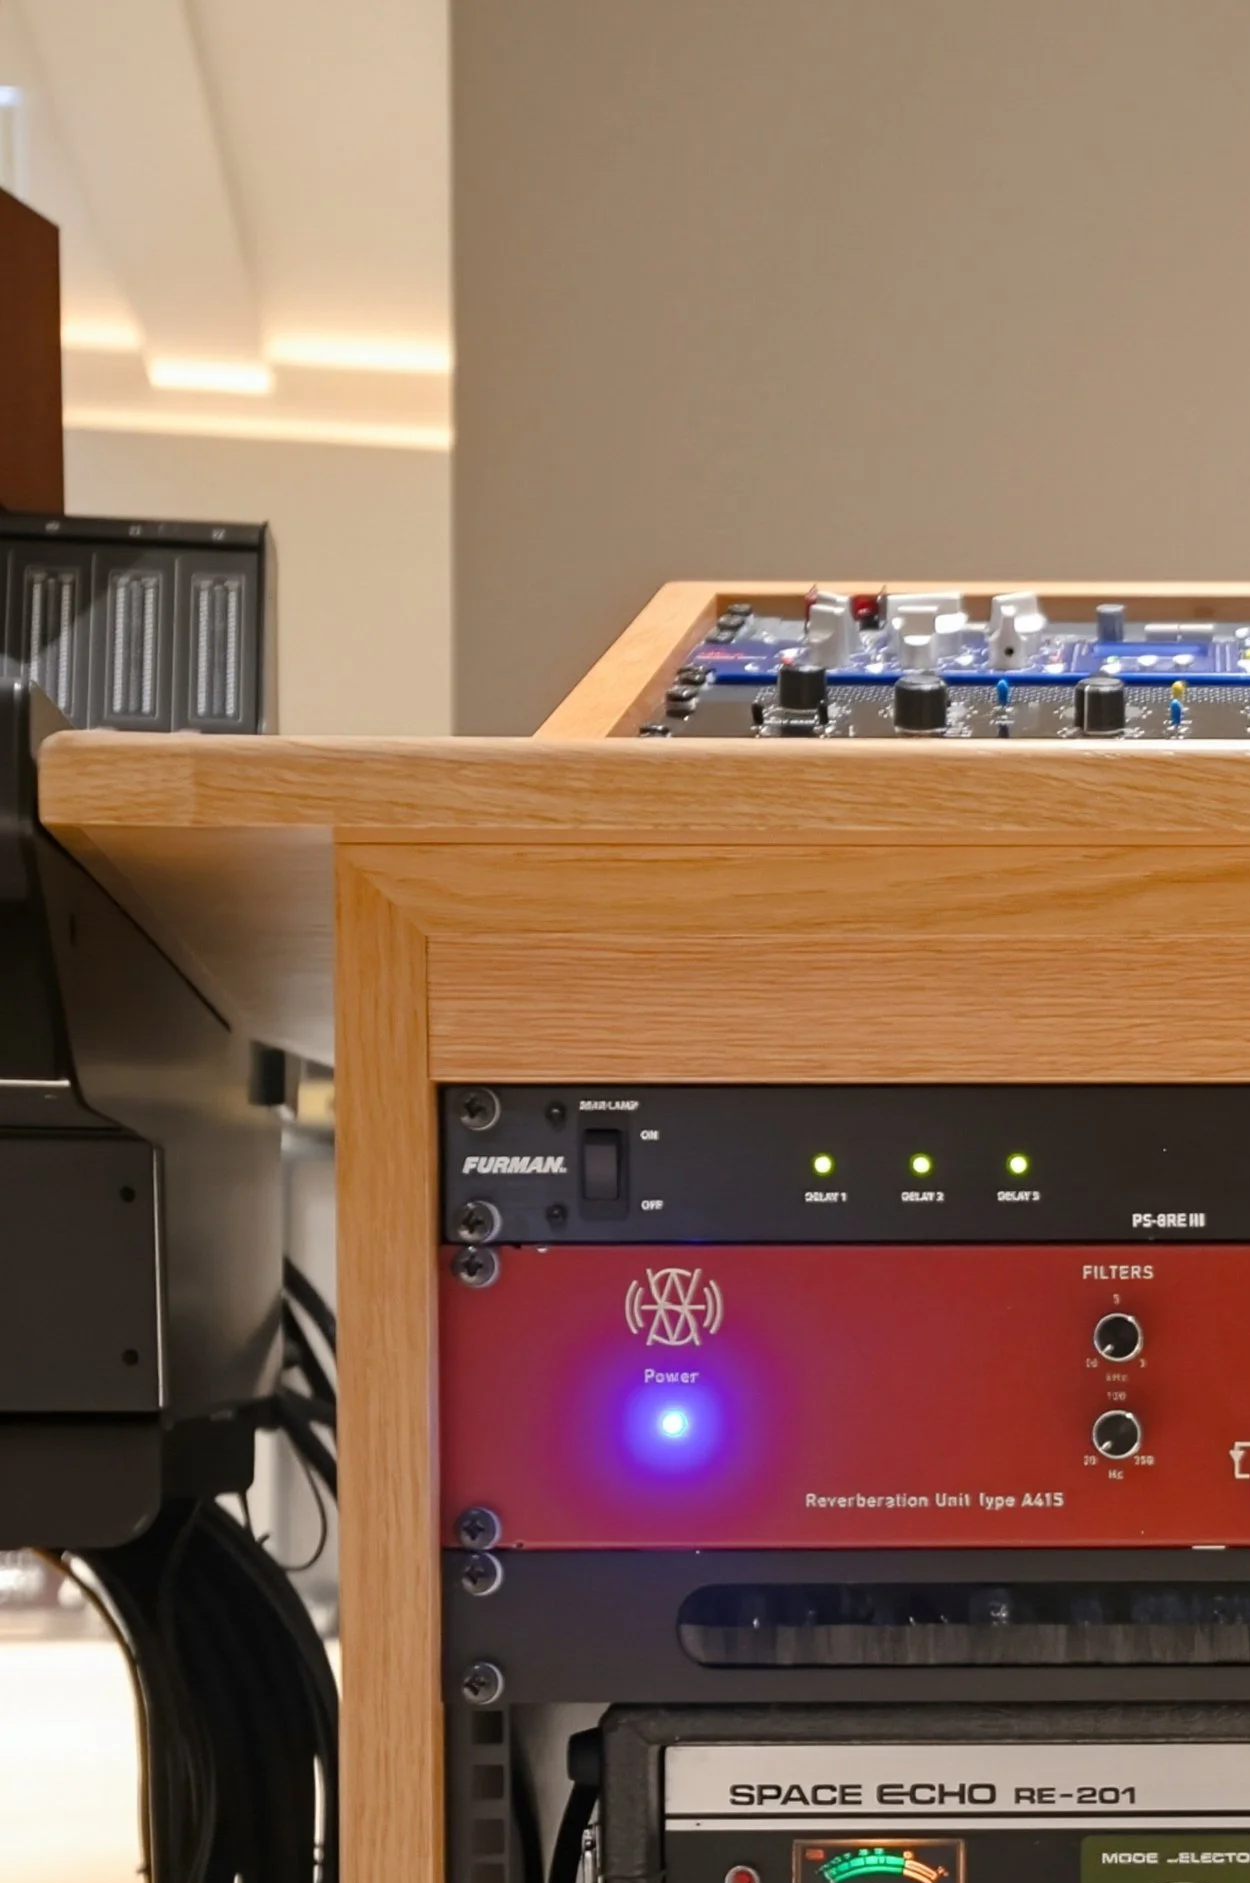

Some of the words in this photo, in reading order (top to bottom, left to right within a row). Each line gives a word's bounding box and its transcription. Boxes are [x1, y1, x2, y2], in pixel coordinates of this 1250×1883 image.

[640, 1130, 659, 1140] ON
[804, 1191, 838, 1203] DELAY
[901, 1191, 934, 1202] DELAY
[641, 1200, 664, 1210] OFF
[1083, 1265, 1154, 1280] FILTERS
[644, 1368, 700, 1383] Power
[805, 1492, 929, 1508] Reverberation
[935, 1492, 971, 1508] Unit
[1021, 1492, 1065, 1508] A415
[729, 1784, 862, 1806] SPACE
[876, 1783, 997, 1805] ECHO
[1014, 1786, 1136, 1805] RE-201
[1102, 1852, 1158, 1864] MODE
